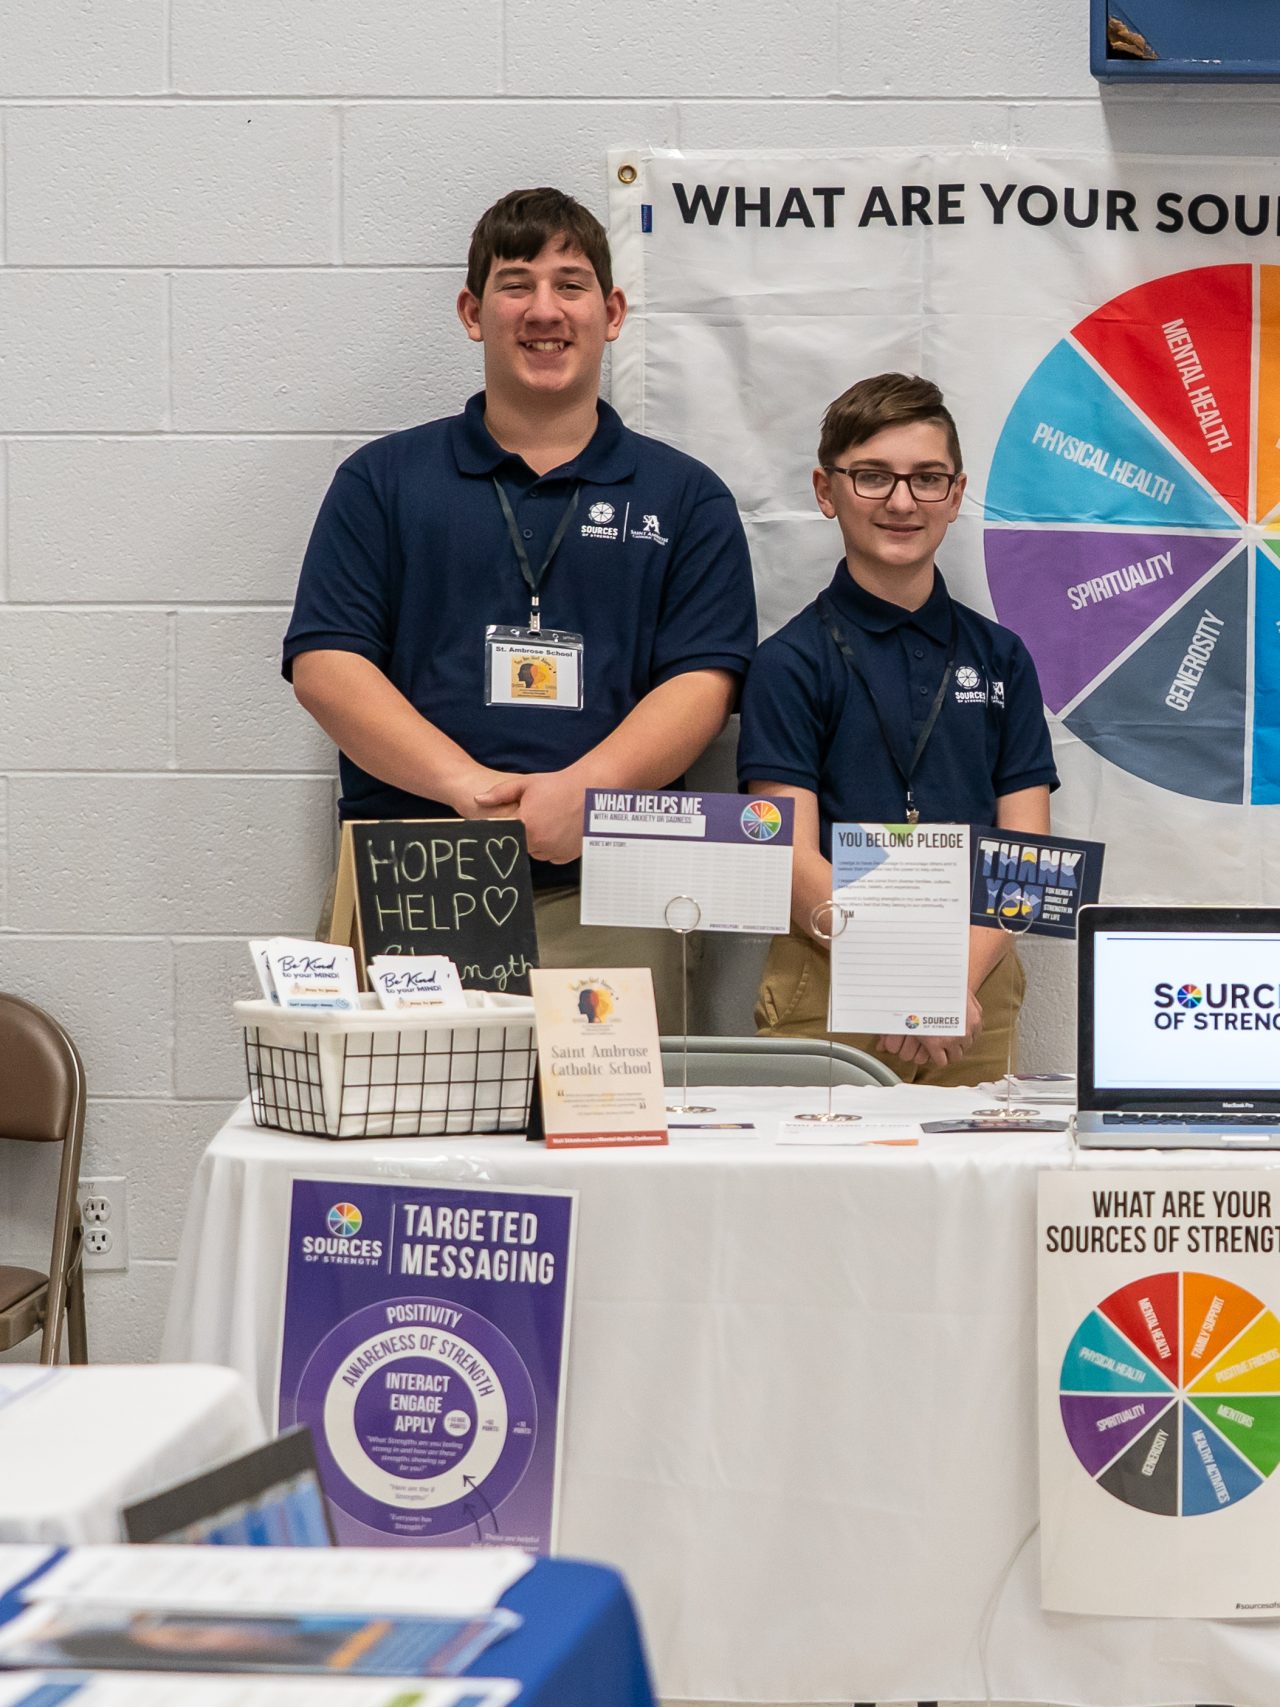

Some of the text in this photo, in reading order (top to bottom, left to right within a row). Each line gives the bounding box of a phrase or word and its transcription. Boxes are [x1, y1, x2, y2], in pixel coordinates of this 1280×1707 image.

[672, 182, 846, 228] WHAT
[858, 183, 965, 228] ARE
[980, 183, 1139, 233] YOUR
[1161, 318, 1233, 454] MENTAL HEALTH
[1031, 422, 1176, 505] PHYSICAL HEALTH
[581, 525, 618, 536] SOURCES
[1067, 551, 1175, 610] SPIRITUALITY
[509, 646, 544, 655] Ambrose
[546, 649, 573, 657] School
[1165, 608, 1225, 712] GENEROSITY
[594, 793, 703, 815] WHAT HELPS ME
[838, 832, 964, 849] YOU BELONG PLEDGE
[367, 839, 478, 884] HOPE
[980, 840, 1082, 889] THANK
[375, 892, 476, 932] HELP
[986, 878, 1043, 919] YOU
[277, 955, 336, 972] Be Kind
[379, 970, 437, 988] Be Kind
[397, 987, 415, 995] your
[922, 1016, 960, 1025] SOURCES
[1154, 1012, 1186, 1030] OF
[551, 1044, 649, 1059] Saint Ambrose
[551, 1061, 652, 1077] Catholic School
[1092, 1190, 1272, 1218] WHAT ARE YOUR
[403, 1204, 538, 1245] TARGETED
[303, 1236, 383, 1258] SOURCES
[1046, 1225, 1147, 1253] SOURCES
[1153, 1225, 1179, 1253] OF
[305, 1254, 379, 1266] OF STRENGTH
[401, 1243, 555, 1285] MESSAGING
[386, 1303, 462, 1329] POSITIVITY
[1138, 1297, 1172, 1359] MENTAL HEALTH
[341, 1334, 496, 1397] AWARENESS OF STRENGTH
[385, 1372, 451, 1393] INTERACT
[390, 1393, 443, 1414] ENGAGE
[1217, 1403, 1255, 1428] MENTORS
[395, 1415, 436, 1434] APPLY
[1096, 1403, 1146, 1432] SPIRITUALITY
[1141, 1428, 1169, 1477] GENEROSITY
[1191, 1429, 1215, 1466] HEALTHY
